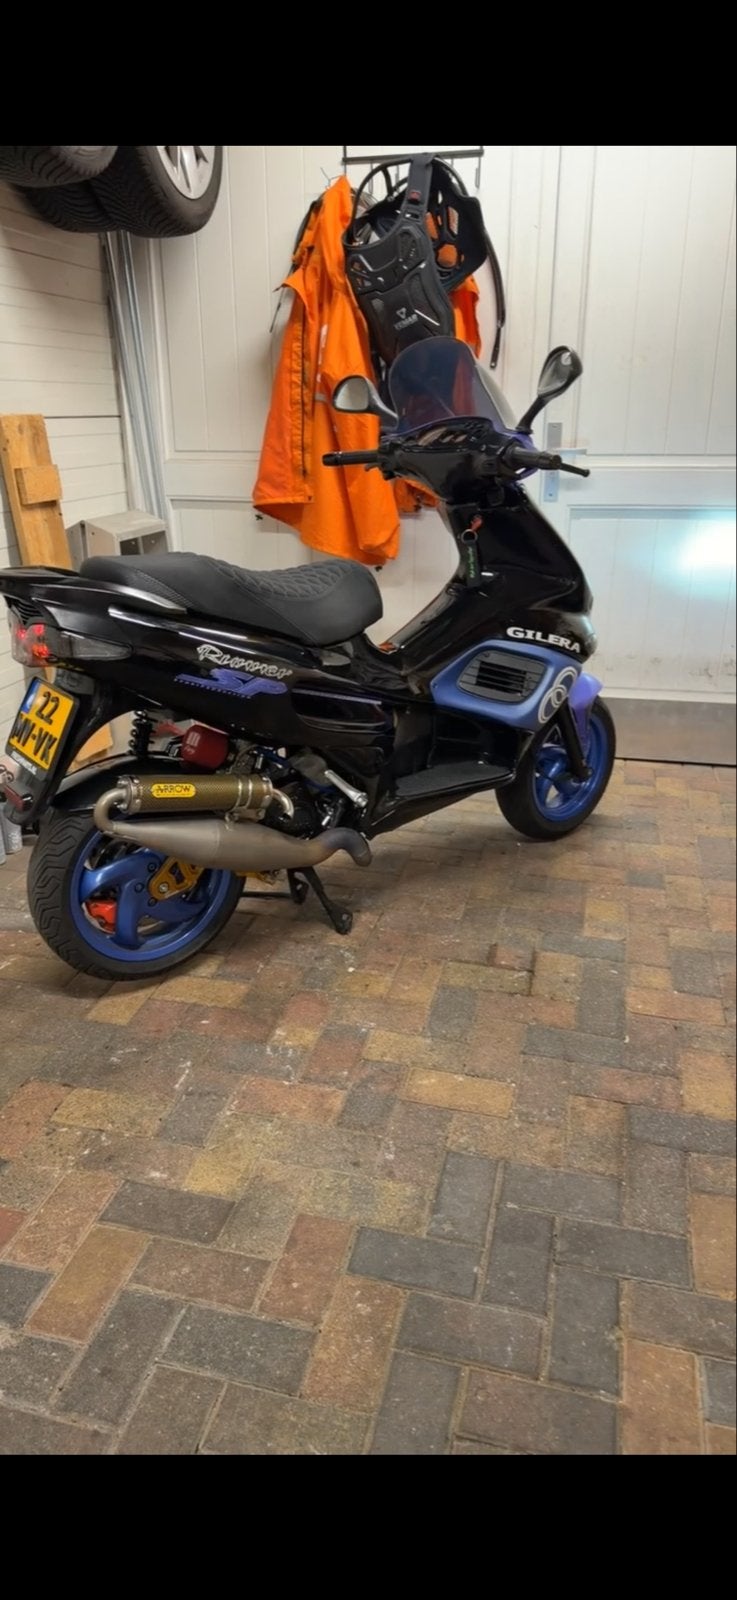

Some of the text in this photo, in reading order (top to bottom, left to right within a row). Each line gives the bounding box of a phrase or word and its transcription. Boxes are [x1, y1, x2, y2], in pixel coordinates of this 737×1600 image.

[506, 626, 581, 653] GILERA
[197, 644, 293, 680] Runner
[176, 668, 288, 697] SP
[36, 691, 60, 725] 22
[155, 784, 191, 794] ARROW
